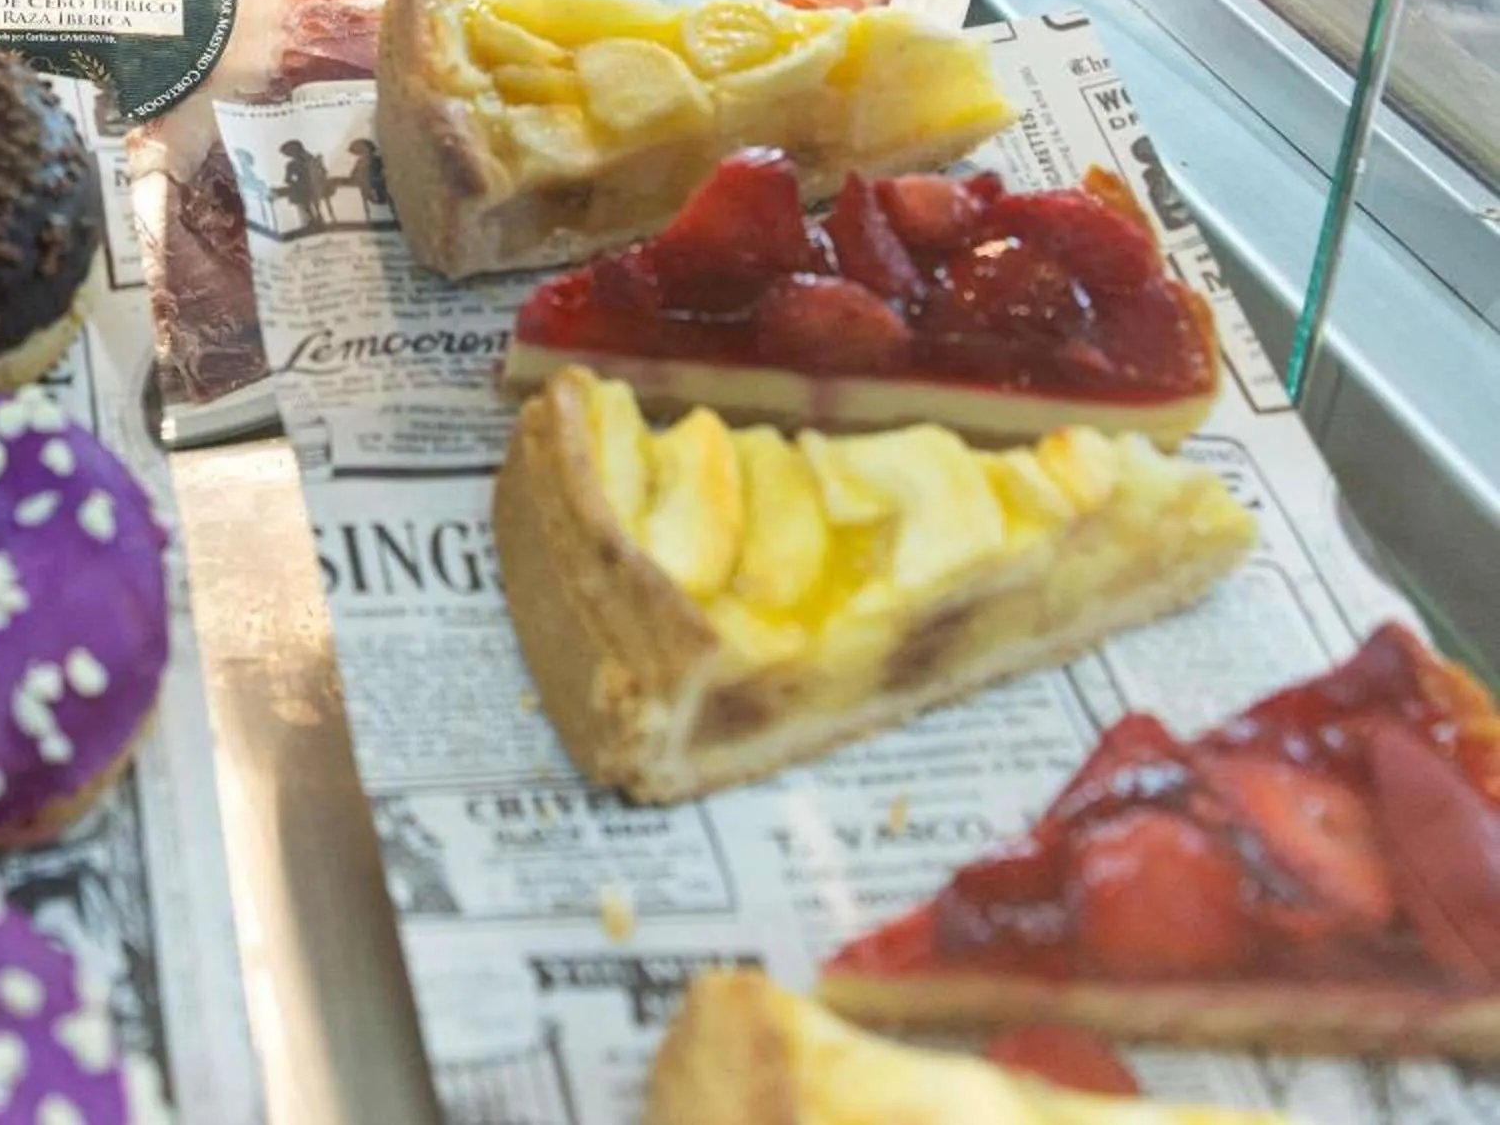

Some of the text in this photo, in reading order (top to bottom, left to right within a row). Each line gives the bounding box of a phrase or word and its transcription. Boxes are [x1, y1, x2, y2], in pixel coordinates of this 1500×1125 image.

[3, 10, 51, 24] RAZA
[196, 17, 231, 70] MAESTRO
[134, 70, 201, 117] CORTADOR
